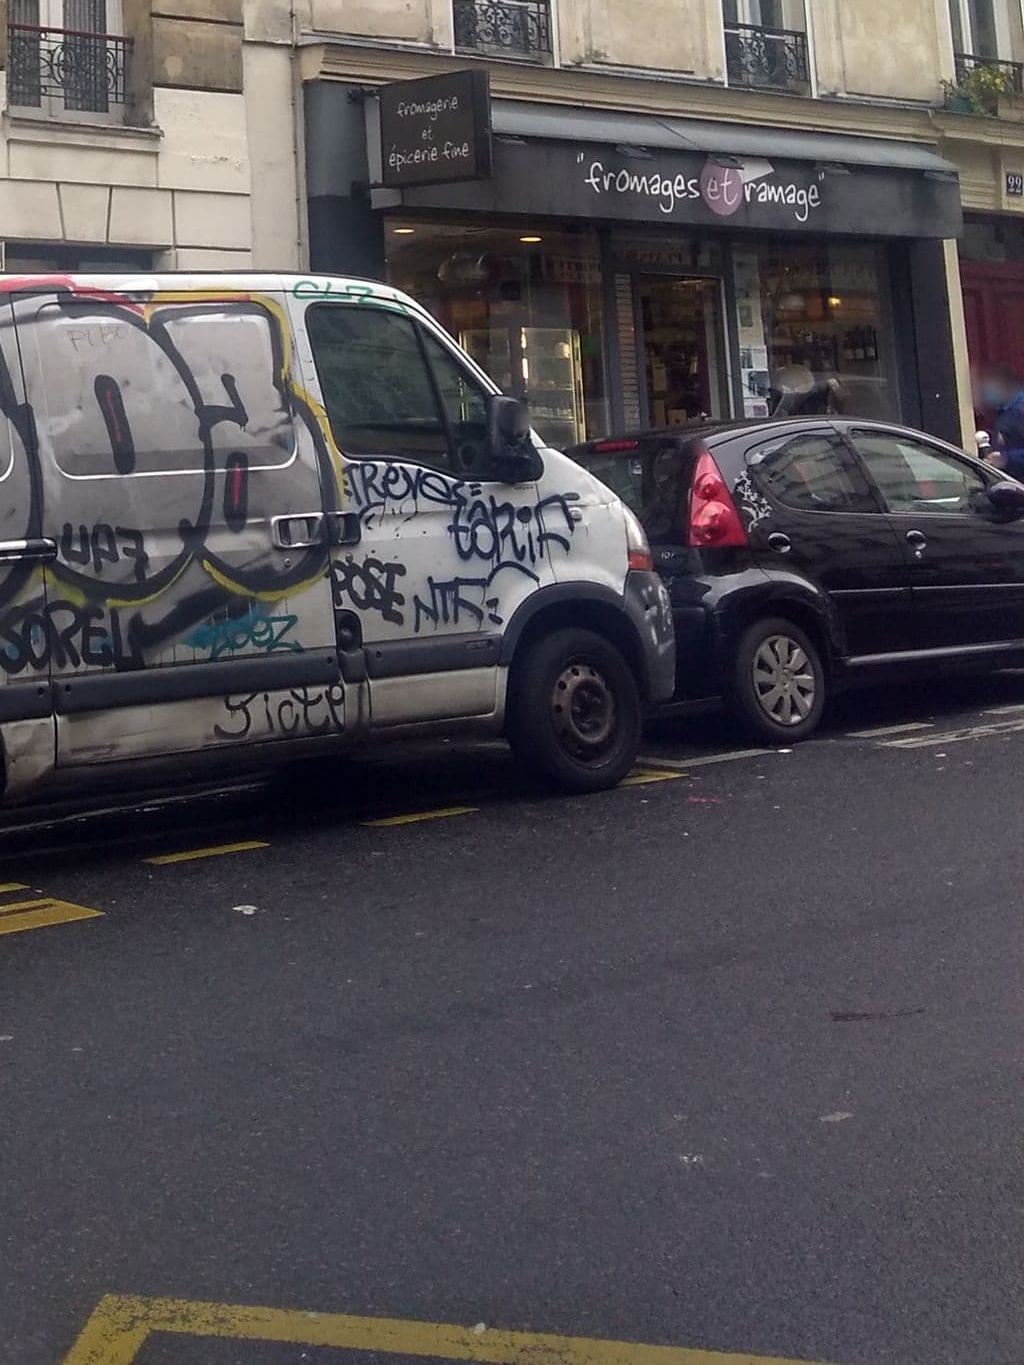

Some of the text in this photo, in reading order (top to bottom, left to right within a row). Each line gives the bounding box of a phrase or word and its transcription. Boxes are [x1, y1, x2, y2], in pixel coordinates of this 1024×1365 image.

[397, 96, 458, 121] fromagerie
[422, 126, 433, 141] et
[389, 142, 469, 172] épicerie fine
[707, 168, 739, 205] et
[1007, 175, 1022, 193] 22
